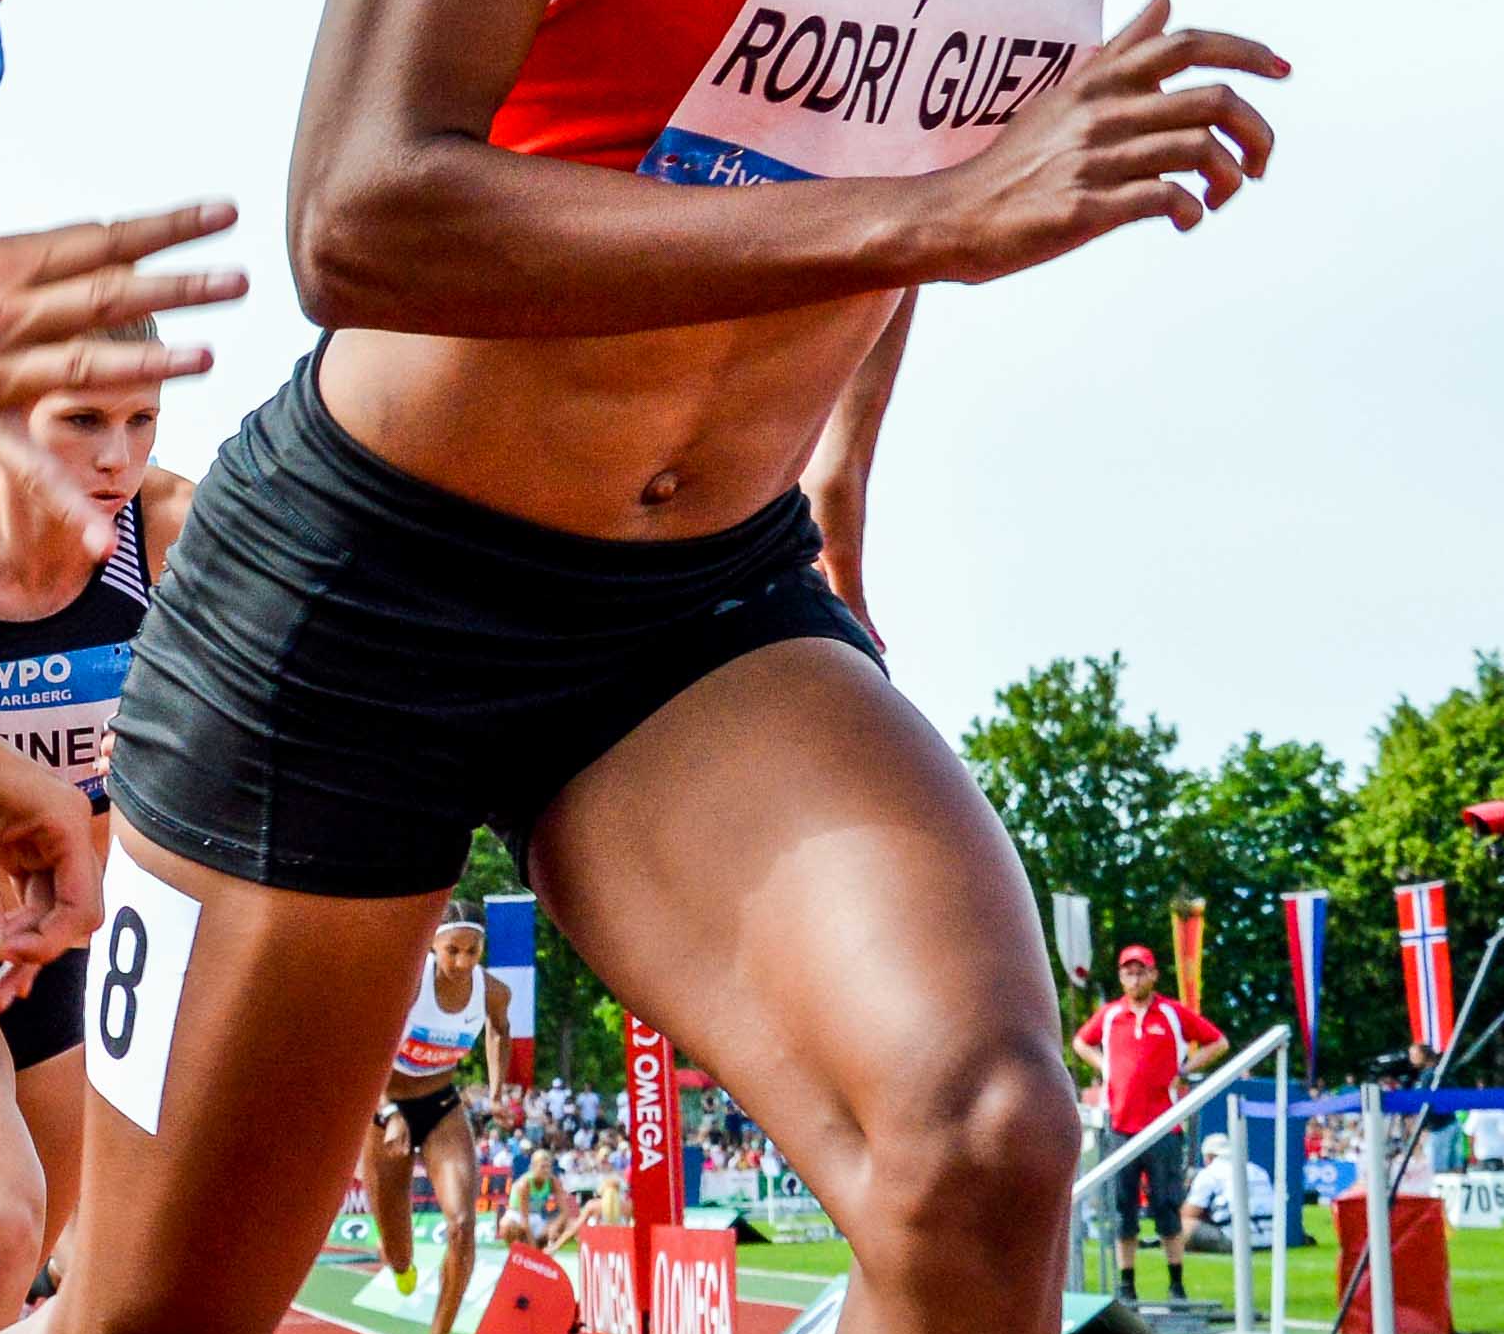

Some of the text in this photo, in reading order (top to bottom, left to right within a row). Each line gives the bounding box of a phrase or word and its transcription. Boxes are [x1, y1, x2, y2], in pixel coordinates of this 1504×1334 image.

[99, 905, 148, 1060] 8
[633, 1053, 665, 1172] OMEGA
[1461, 1183, 1491, 1213] 70
